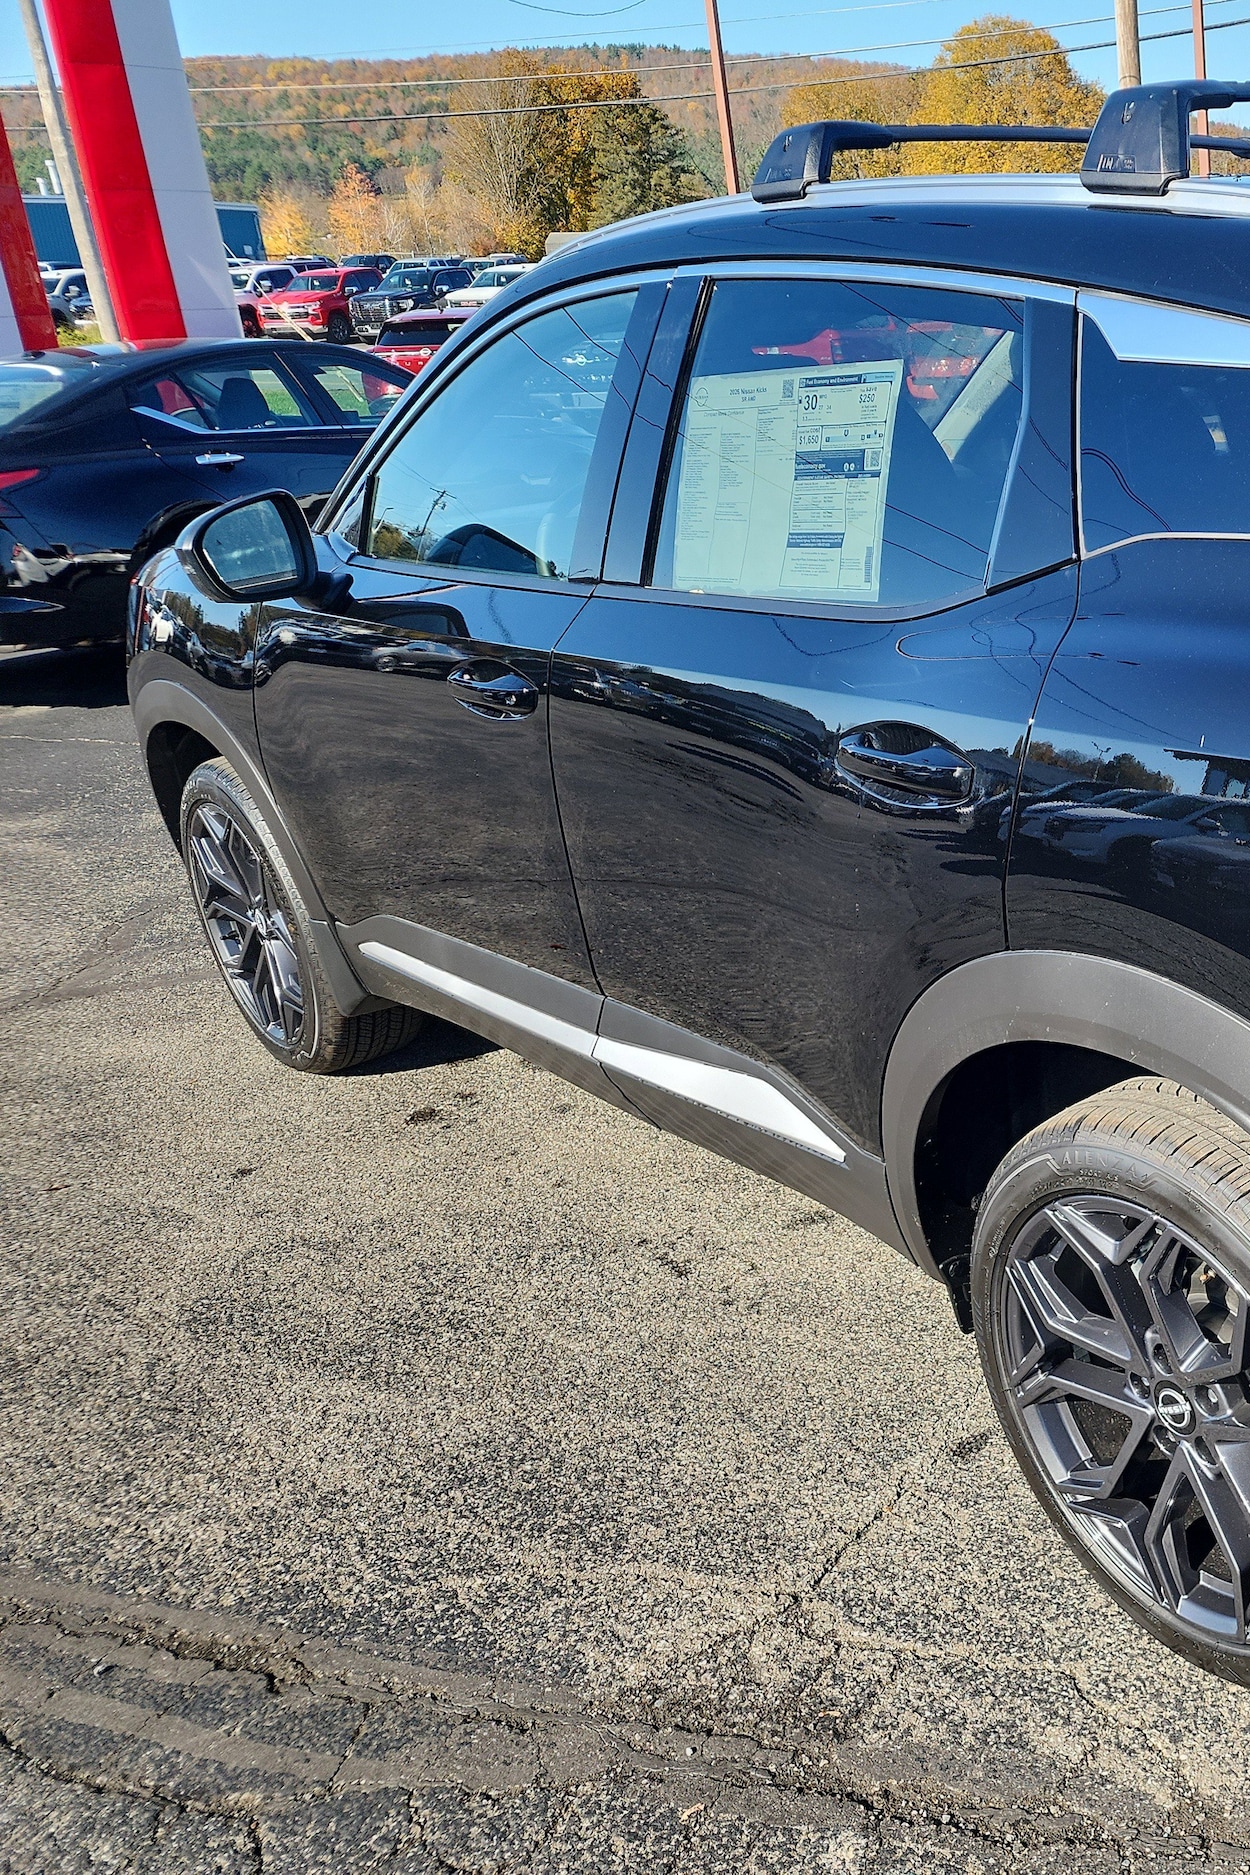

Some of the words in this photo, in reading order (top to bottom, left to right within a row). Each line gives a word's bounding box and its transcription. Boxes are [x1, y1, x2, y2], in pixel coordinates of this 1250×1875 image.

[804, 394, 818, 410] 30
[859, 393, 876, 403] $250
[800, 435, 819, 445] $1,650
[1062, 1150, 1139, 1180] ALENZA
